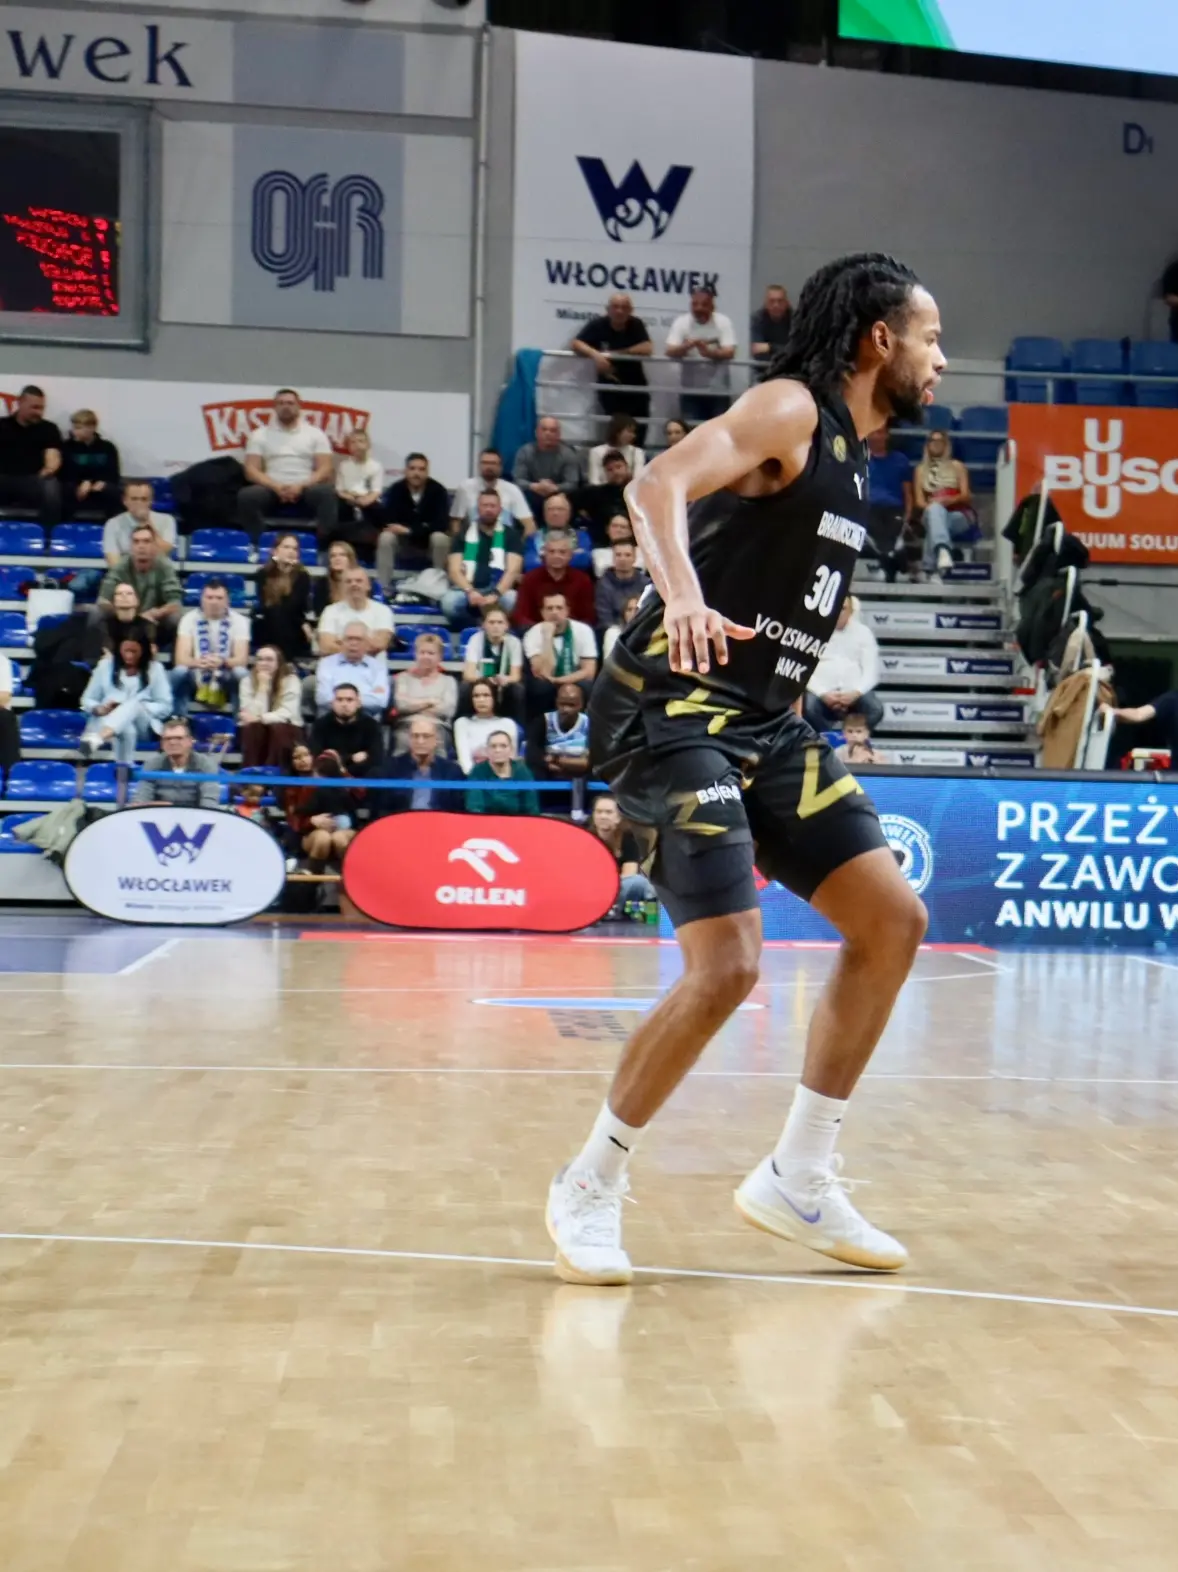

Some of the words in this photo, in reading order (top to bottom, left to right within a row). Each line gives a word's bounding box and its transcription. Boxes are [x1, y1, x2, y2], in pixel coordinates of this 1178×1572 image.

[6, 24, 193, 87] wek
[545, 259, 719, 297] WŁOCŁAWEK
[803, 564, 842, 617] 30
[118, 876, 232, 893] WŁOCŁAWEK
[994, 853, 1025, 889] Z
[435, 885, 526, 907] ORLEN
[995, 899, 1150, 930] ANWILU
